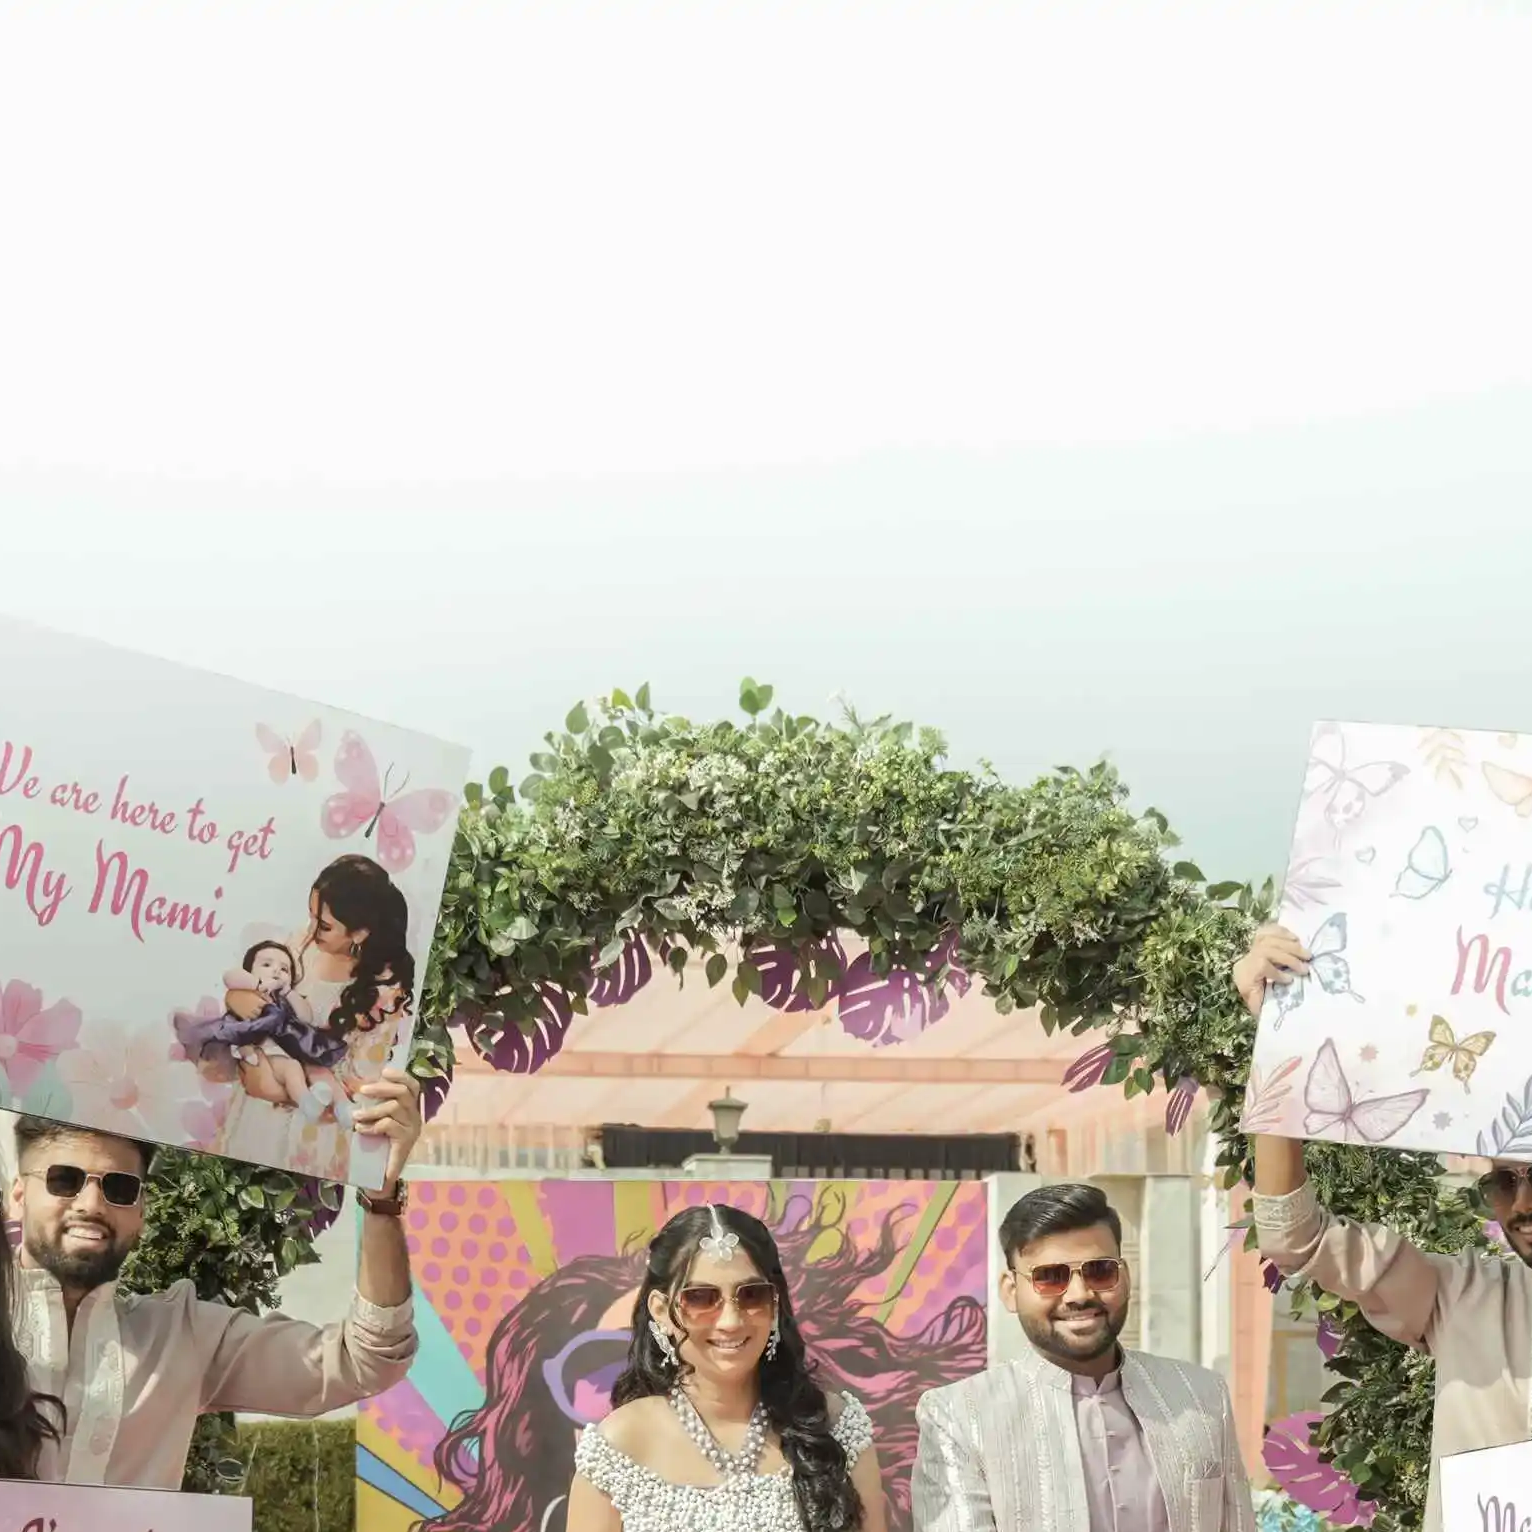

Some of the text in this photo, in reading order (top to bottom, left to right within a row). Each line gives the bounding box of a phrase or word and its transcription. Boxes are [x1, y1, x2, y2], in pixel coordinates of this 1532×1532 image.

[51, 782, 102, 814] are
[111, 775, 175, 834] here
[187, 798, 218, 844] to
[227, 817, 275, 873] get
[88, 839, 223, 943] Mami
